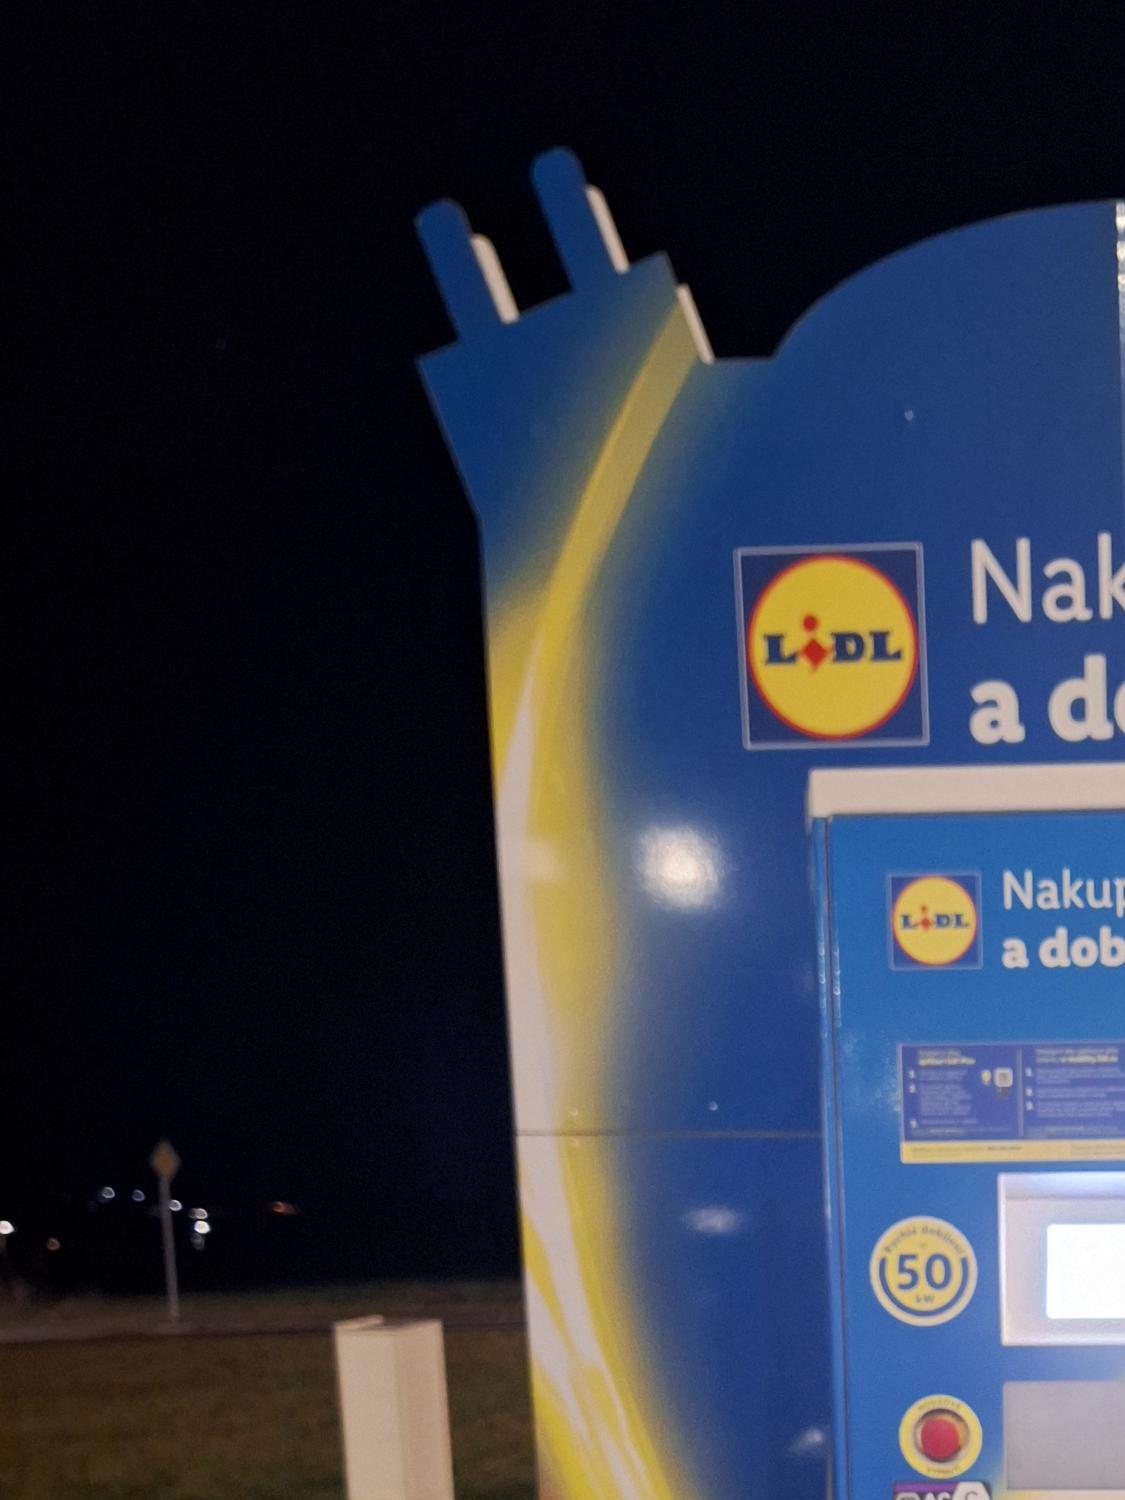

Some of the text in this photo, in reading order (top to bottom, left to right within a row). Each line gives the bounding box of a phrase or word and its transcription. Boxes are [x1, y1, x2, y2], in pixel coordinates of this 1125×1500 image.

[969, 680, 1026, 744] a
[1002, 936, 1030, 969] a
[898, 1253, 952, 1291] 50
